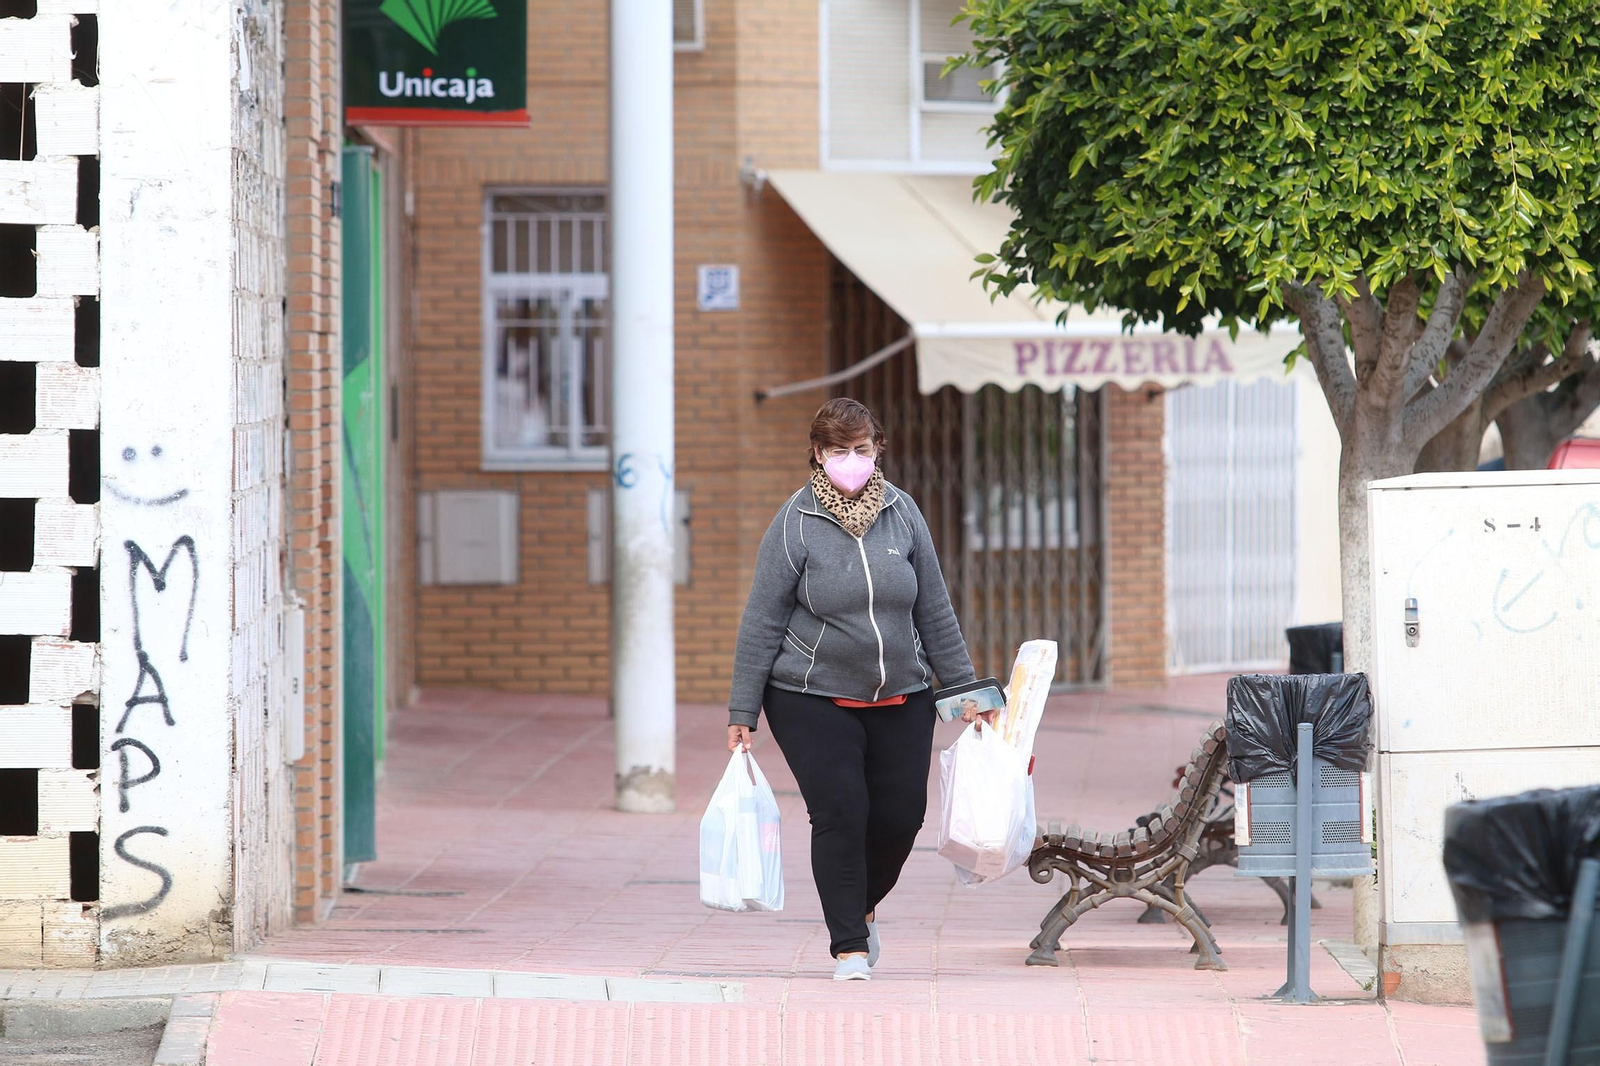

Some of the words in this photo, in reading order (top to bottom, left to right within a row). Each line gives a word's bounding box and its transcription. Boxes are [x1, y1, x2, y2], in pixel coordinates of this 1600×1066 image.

[379, 67, 495, 104] Unicaja
[1013, 338, 1233, 376] PIZZERIA
[103, 534, 199, 920] MAPS
